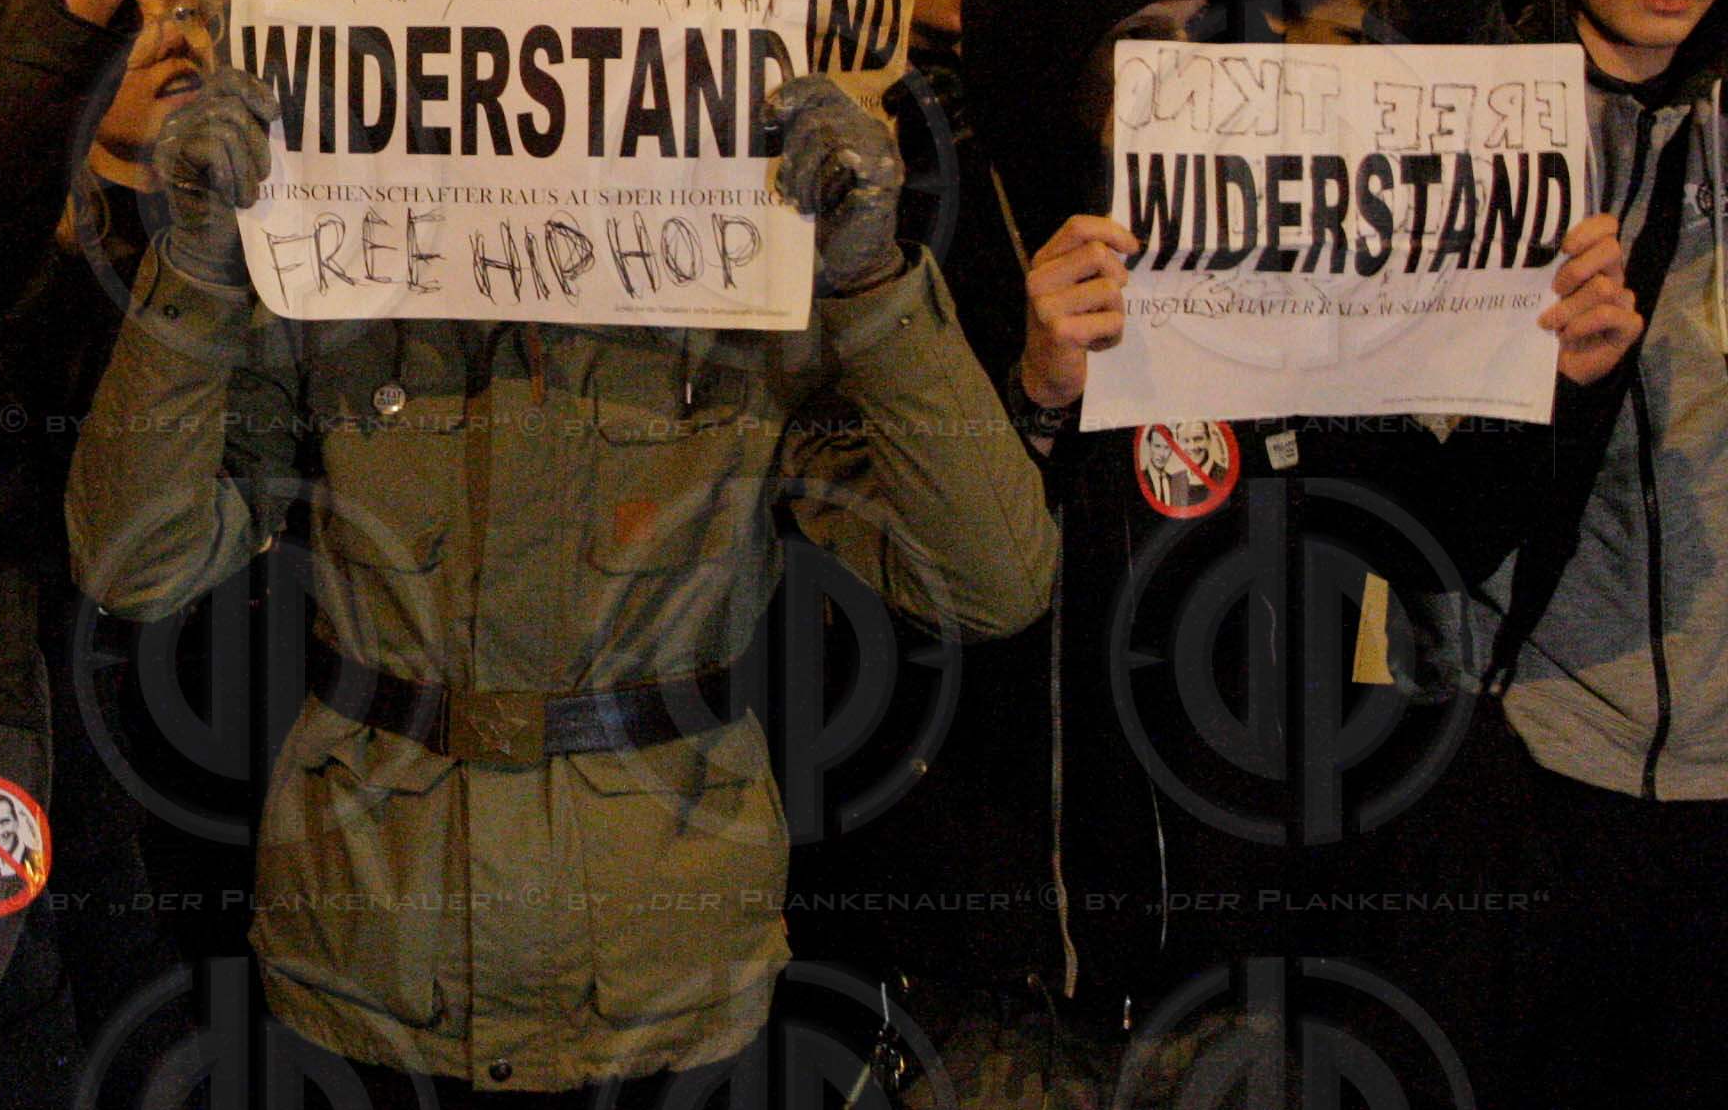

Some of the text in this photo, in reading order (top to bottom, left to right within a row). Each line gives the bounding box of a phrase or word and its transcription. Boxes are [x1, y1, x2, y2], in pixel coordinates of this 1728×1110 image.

[241, 24, 794, 159] WIDERSTAND
[257, 182, 494, 206] BURSCHENSCHAFTER
[499, 186, 559, 206] RAUS
[566, 187, 611, 206] AUS
[616, 188, 663, 206] DER
[1125, 150, 1572, 277] WIDERSTAND
[263, 207, 448, 312] FREE
